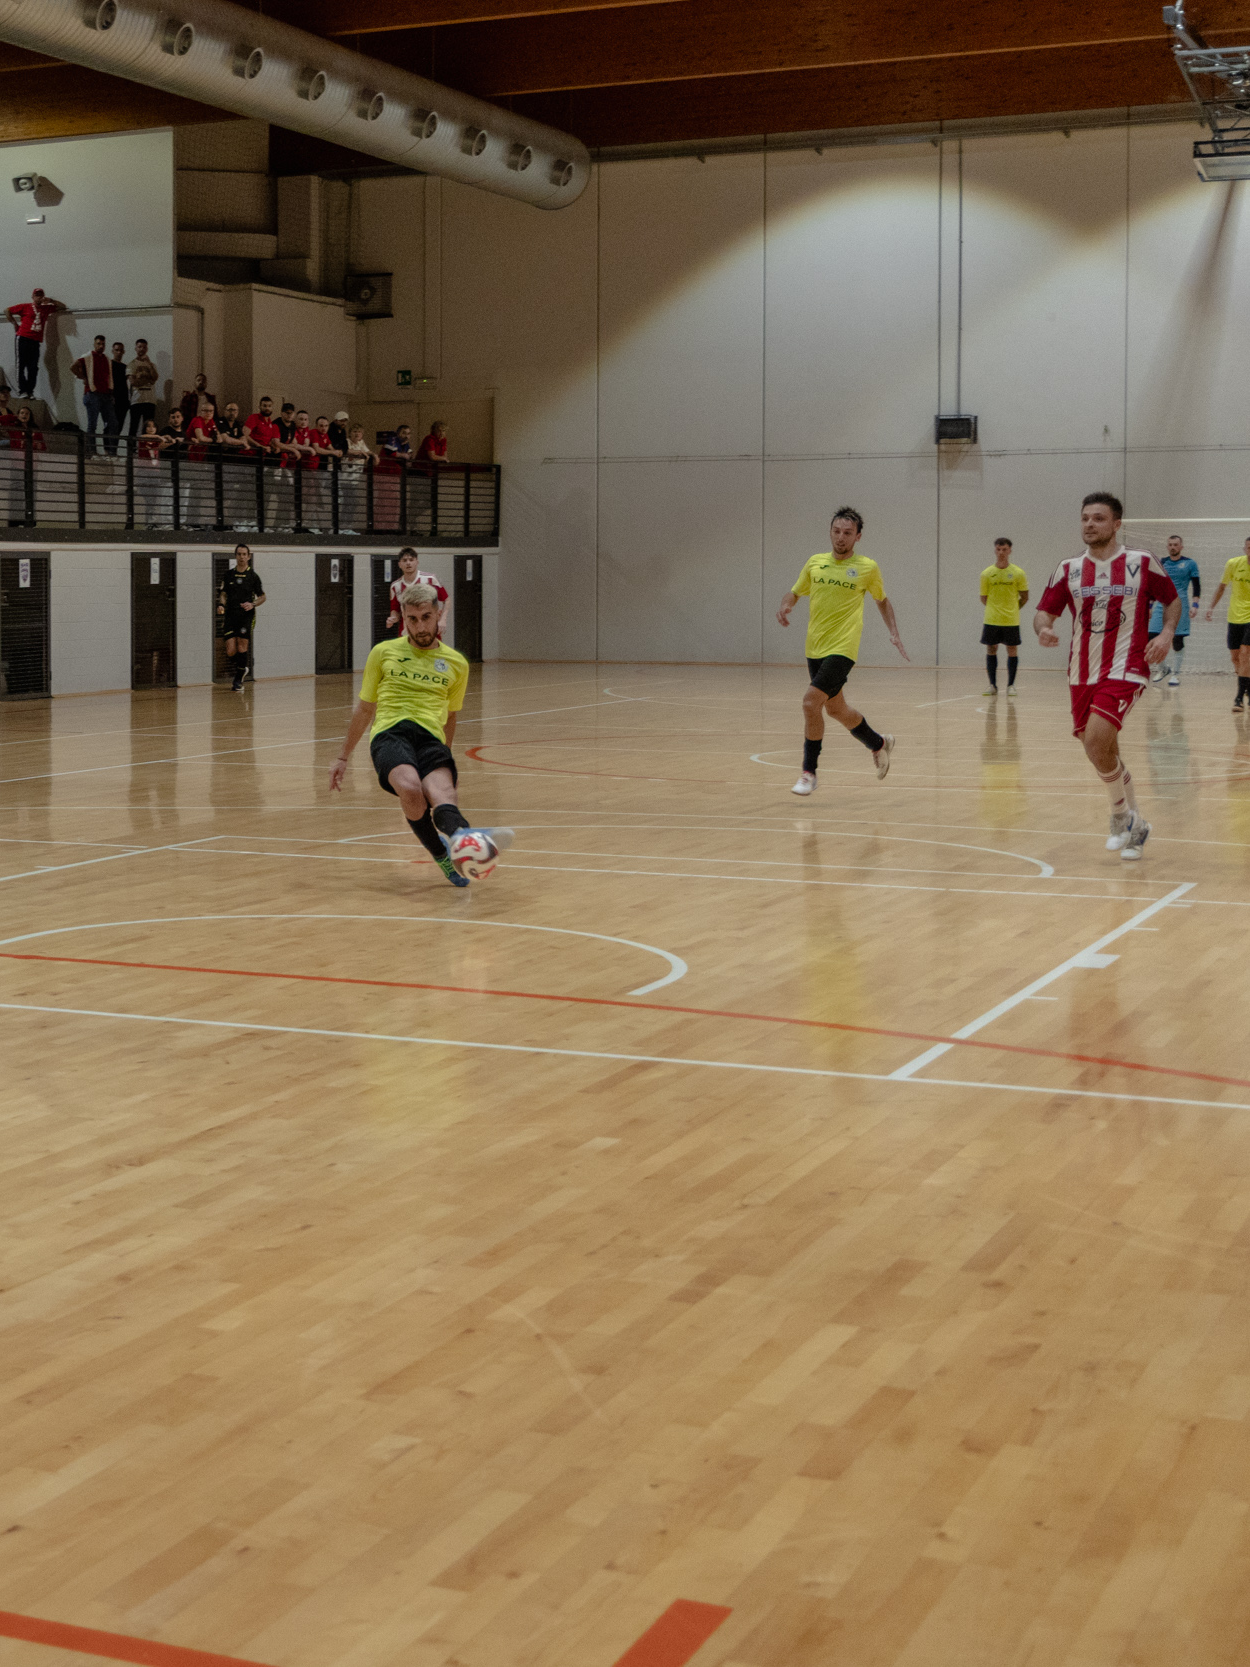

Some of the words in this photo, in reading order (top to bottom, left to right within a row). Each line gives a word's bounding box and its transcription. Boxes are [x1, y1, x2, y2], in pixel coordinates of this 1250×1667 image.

[1126, 564, 1140, 578] V
[828, 578, 857, 590] PACE
[390, 669, 408, 679] LA
[412, 673, 449, 687] PACE
